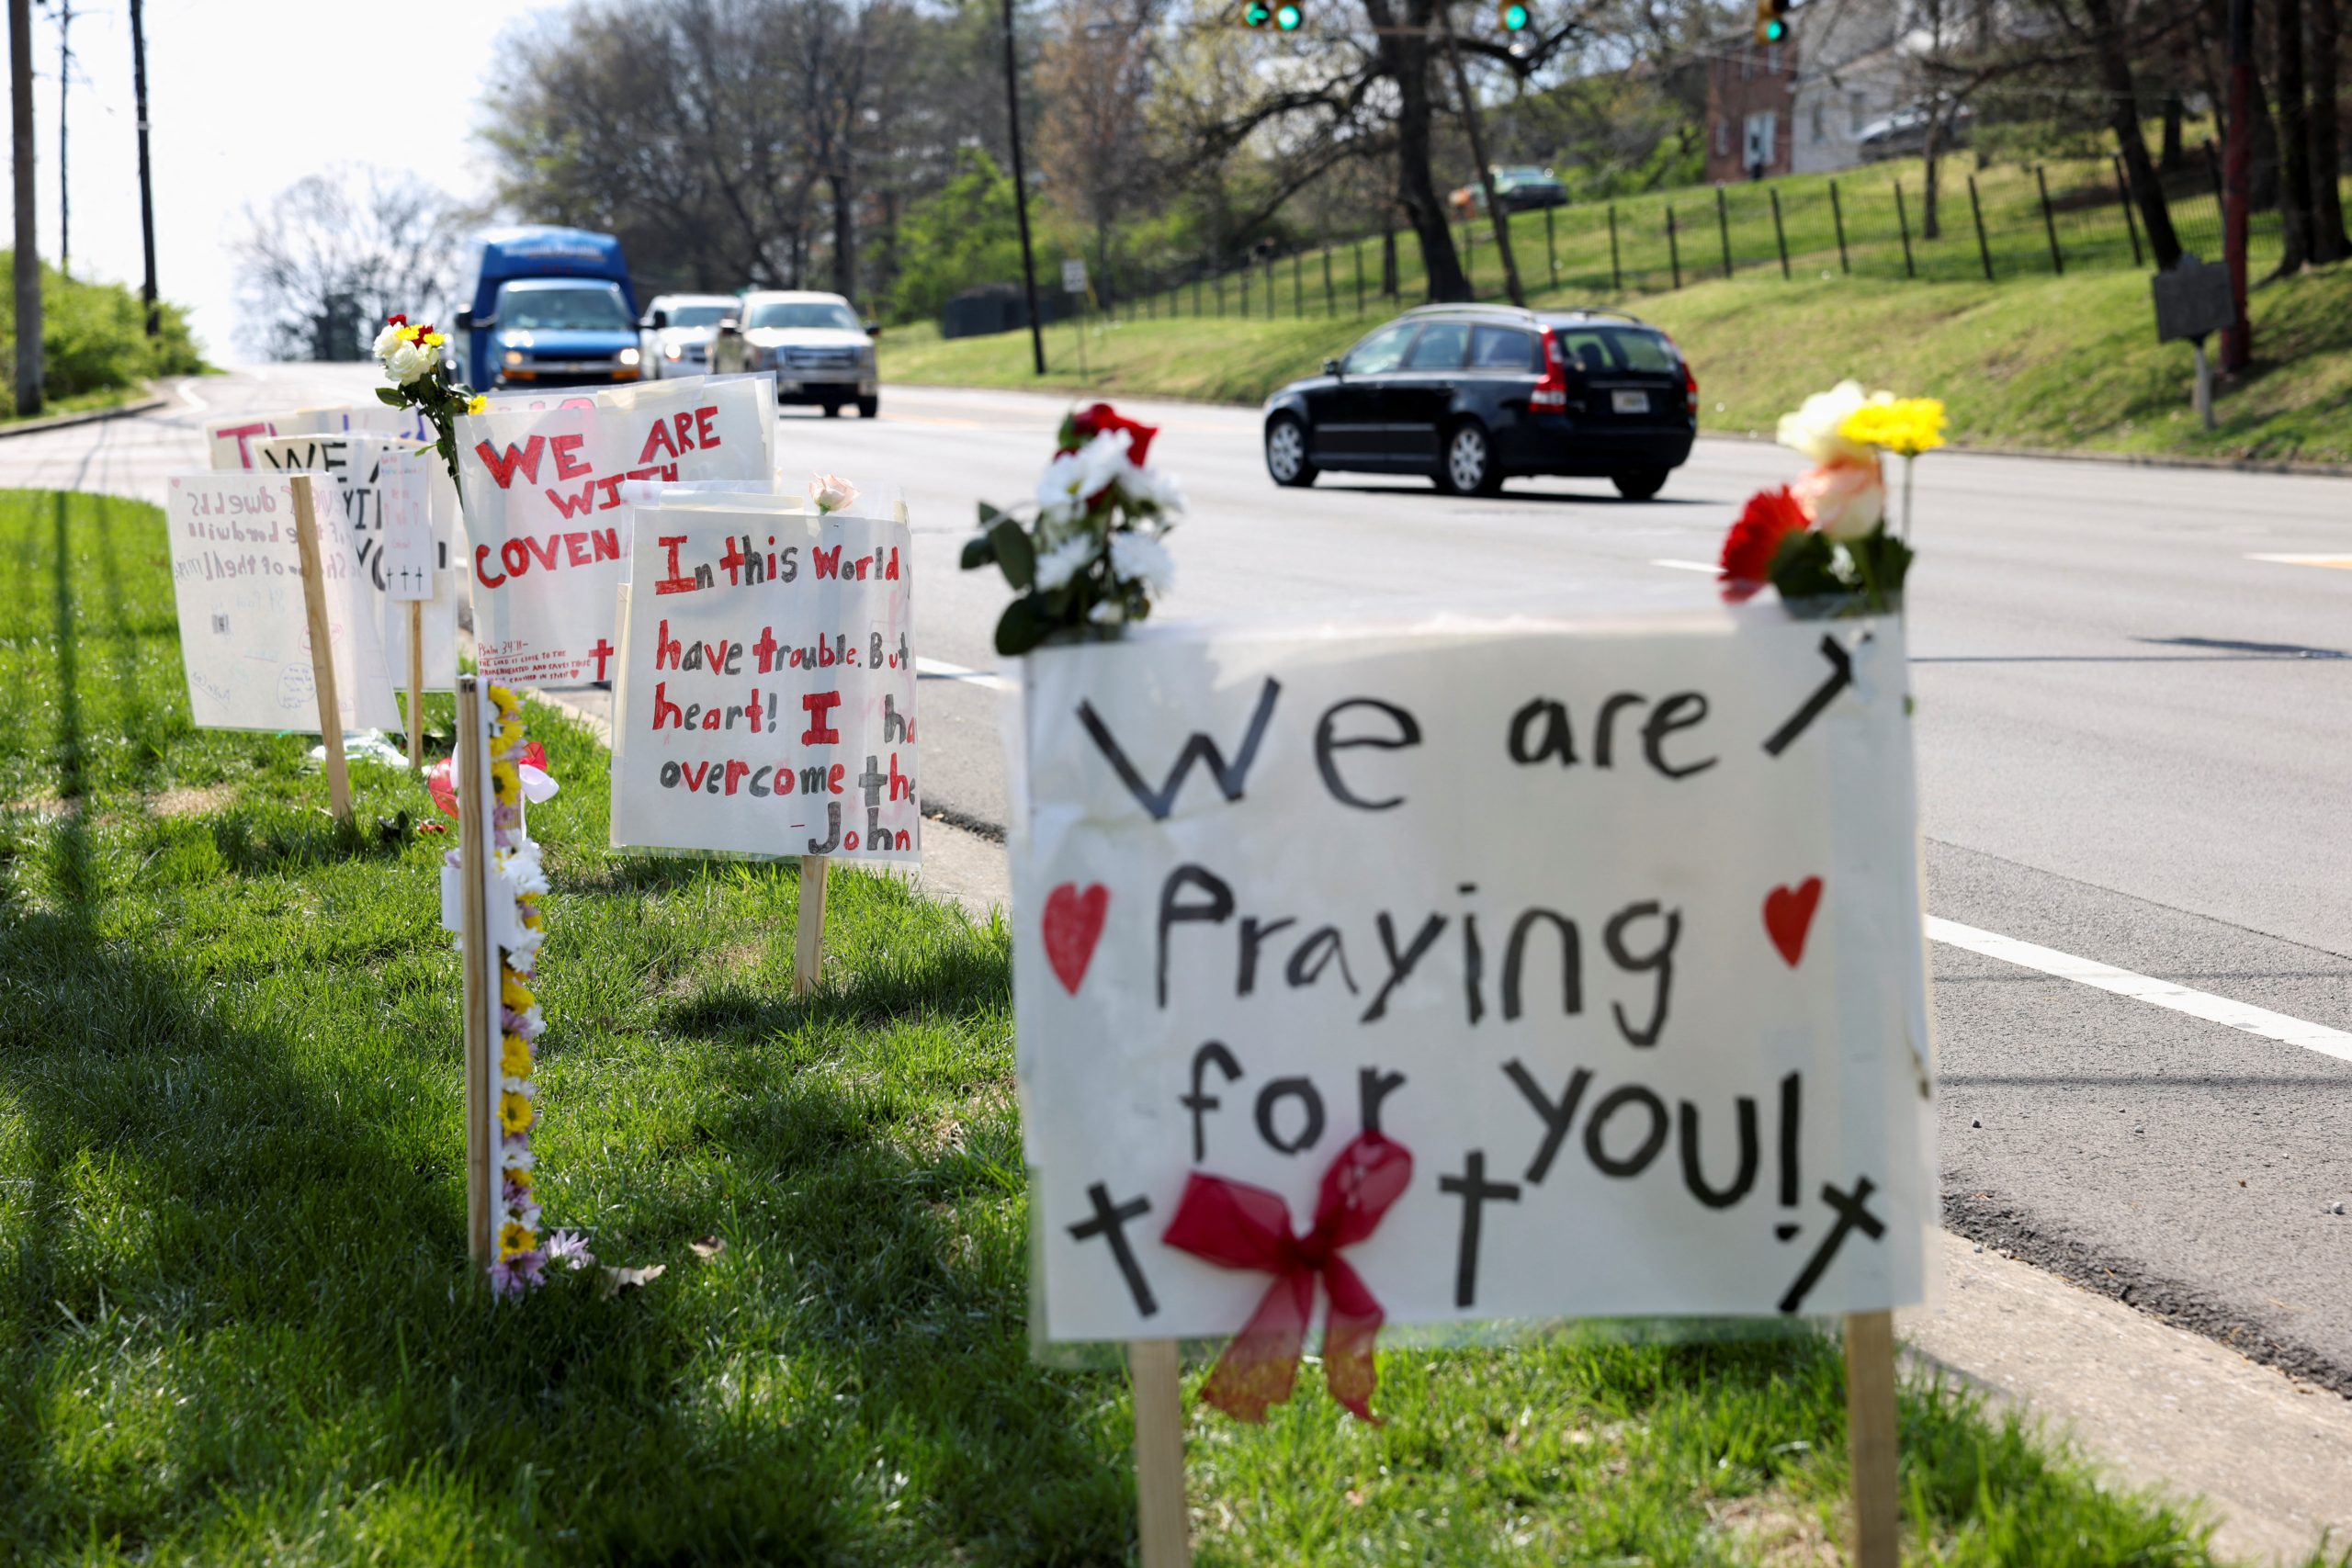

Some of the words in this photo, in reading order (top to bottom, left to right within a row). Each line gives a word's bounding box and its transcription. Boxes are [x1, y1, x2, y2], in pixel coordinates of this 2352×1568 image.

[475, 434, 593, 490] WE
[638, 405, 721, 465] ARE
[475, 527, 625, 589] COVEN
[654, 535, 716, 595] In
[718, 534, 798, 587] this
[478, 642, 499, 658] Psalm
[479, 659, 490, 667] THE
[493, 658, 509, 666] LORD
[541, 651, 550, 660] TO
[532, 662, 548, 672] AND
[548, 661, 570, 671] SAVES
[539, 672, 548, 681] IN
[655, 619, 743, 677] have
[752, 626, 862, 675] trouble.
[868, 630, 909, 671] But
[651, 682, 778, 734] heart!
[800, 690, 841, 747] I
[660, 758, 846, 798] overcome
[858, 751, 916, 808] the
[1077, 676, 1423, 822] We
[1507, 690, 1720, 780] are
[1155, 863, 1683, 1047] Praying
[1179, 1040, 1407, 1164] for
